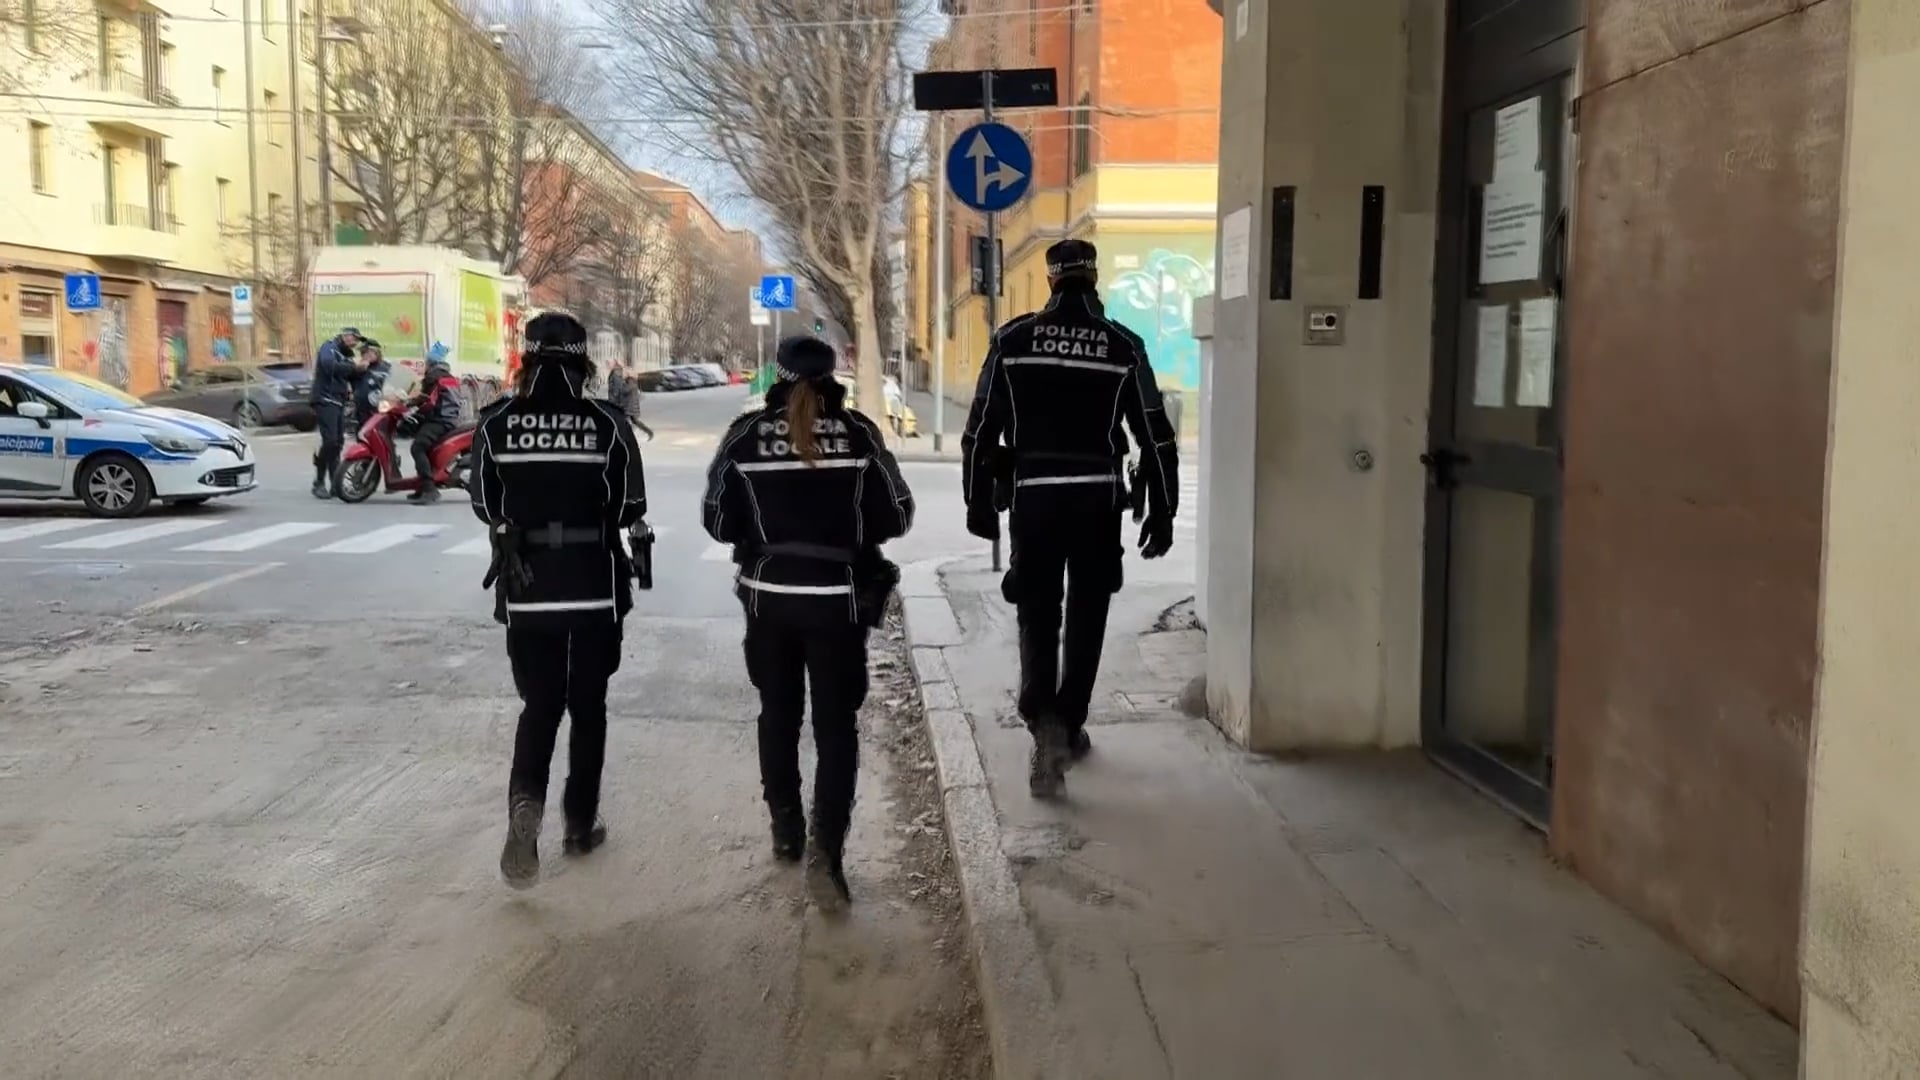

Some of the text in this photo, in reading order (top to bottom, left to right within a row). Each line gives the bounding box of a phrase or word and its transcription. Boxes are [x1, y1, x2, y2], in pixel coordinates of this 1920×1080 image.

[1033, 325, 1108, 344] POLIZIA
[1032, 340, 1108, 358] LOCALE
[507, 414, 597, 430] POLIZIA
[758, 418, 847, 436] POZIA
[506, 433, 597, 449] LOCALE
